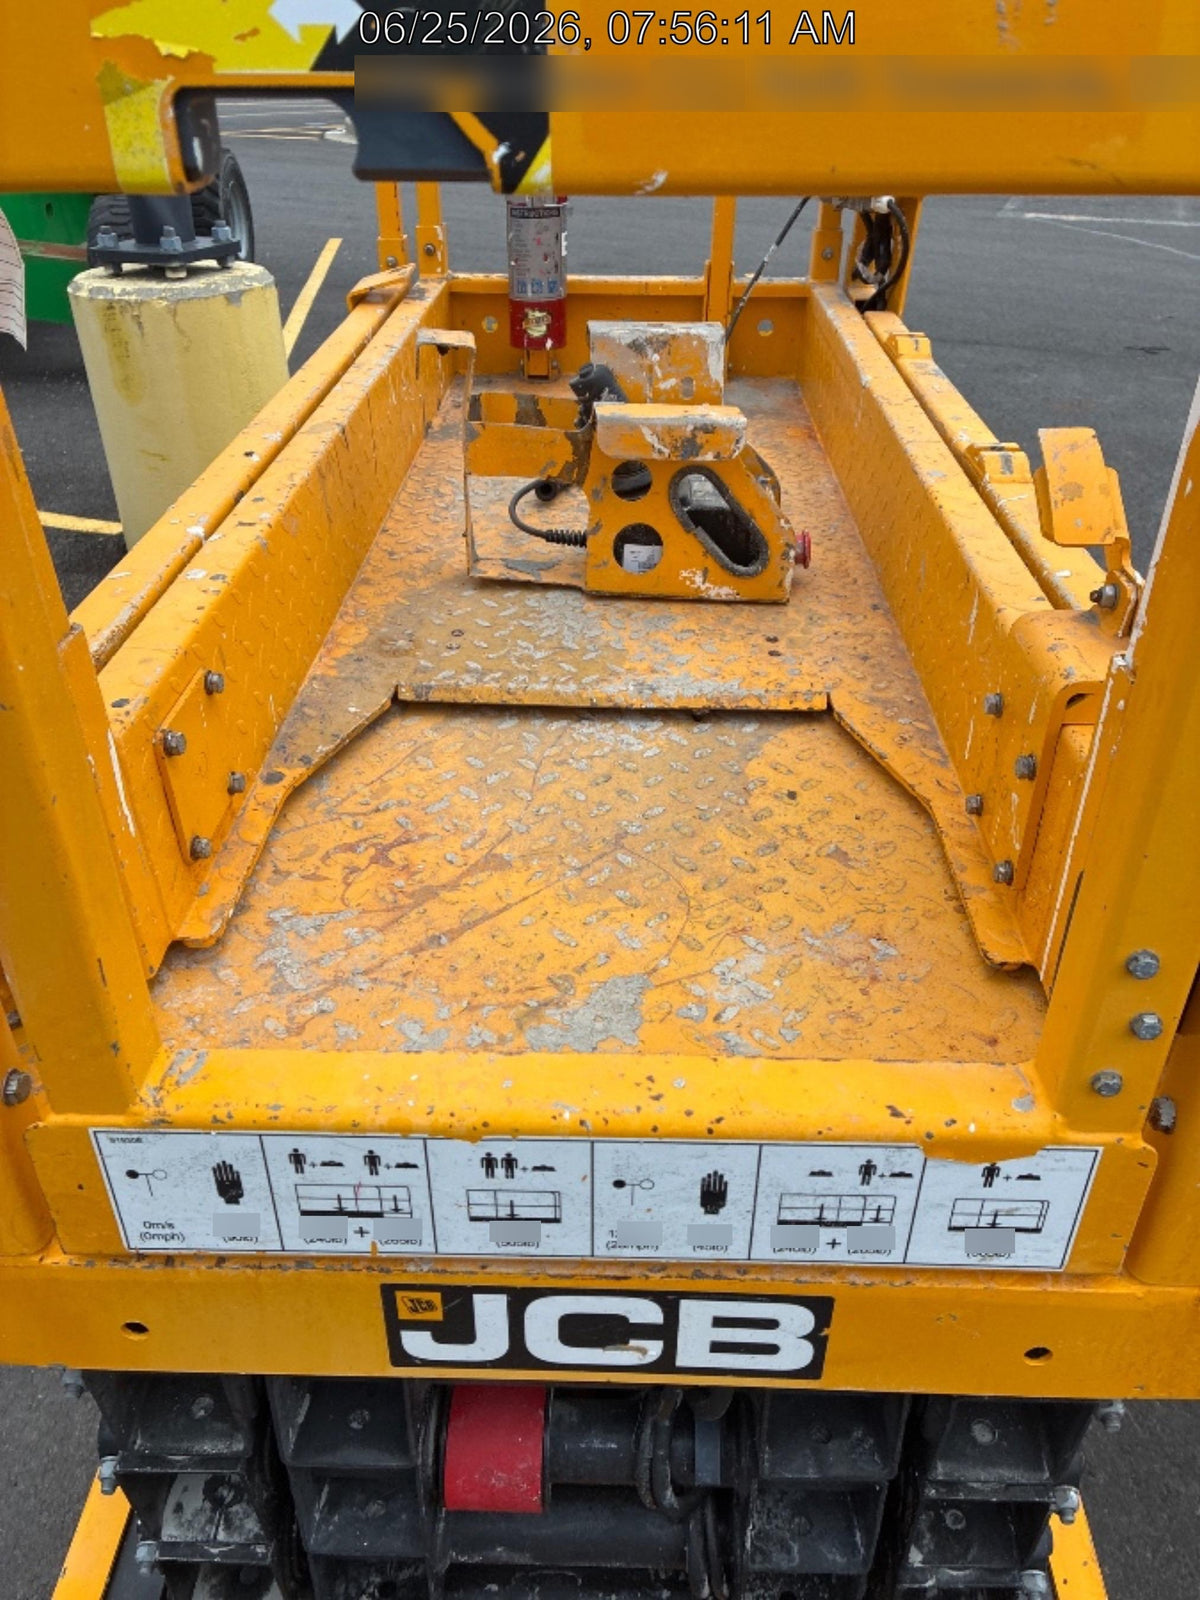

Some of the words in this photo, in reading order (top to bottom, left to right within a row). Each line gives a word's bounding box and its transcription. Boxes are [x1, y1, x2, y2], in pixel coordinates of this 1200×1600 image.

[139, 1231, 186, 1243] (0mph)
[401, 1296, 438, 1314] JCB
[400, 1292, 816, 1373] JCB
